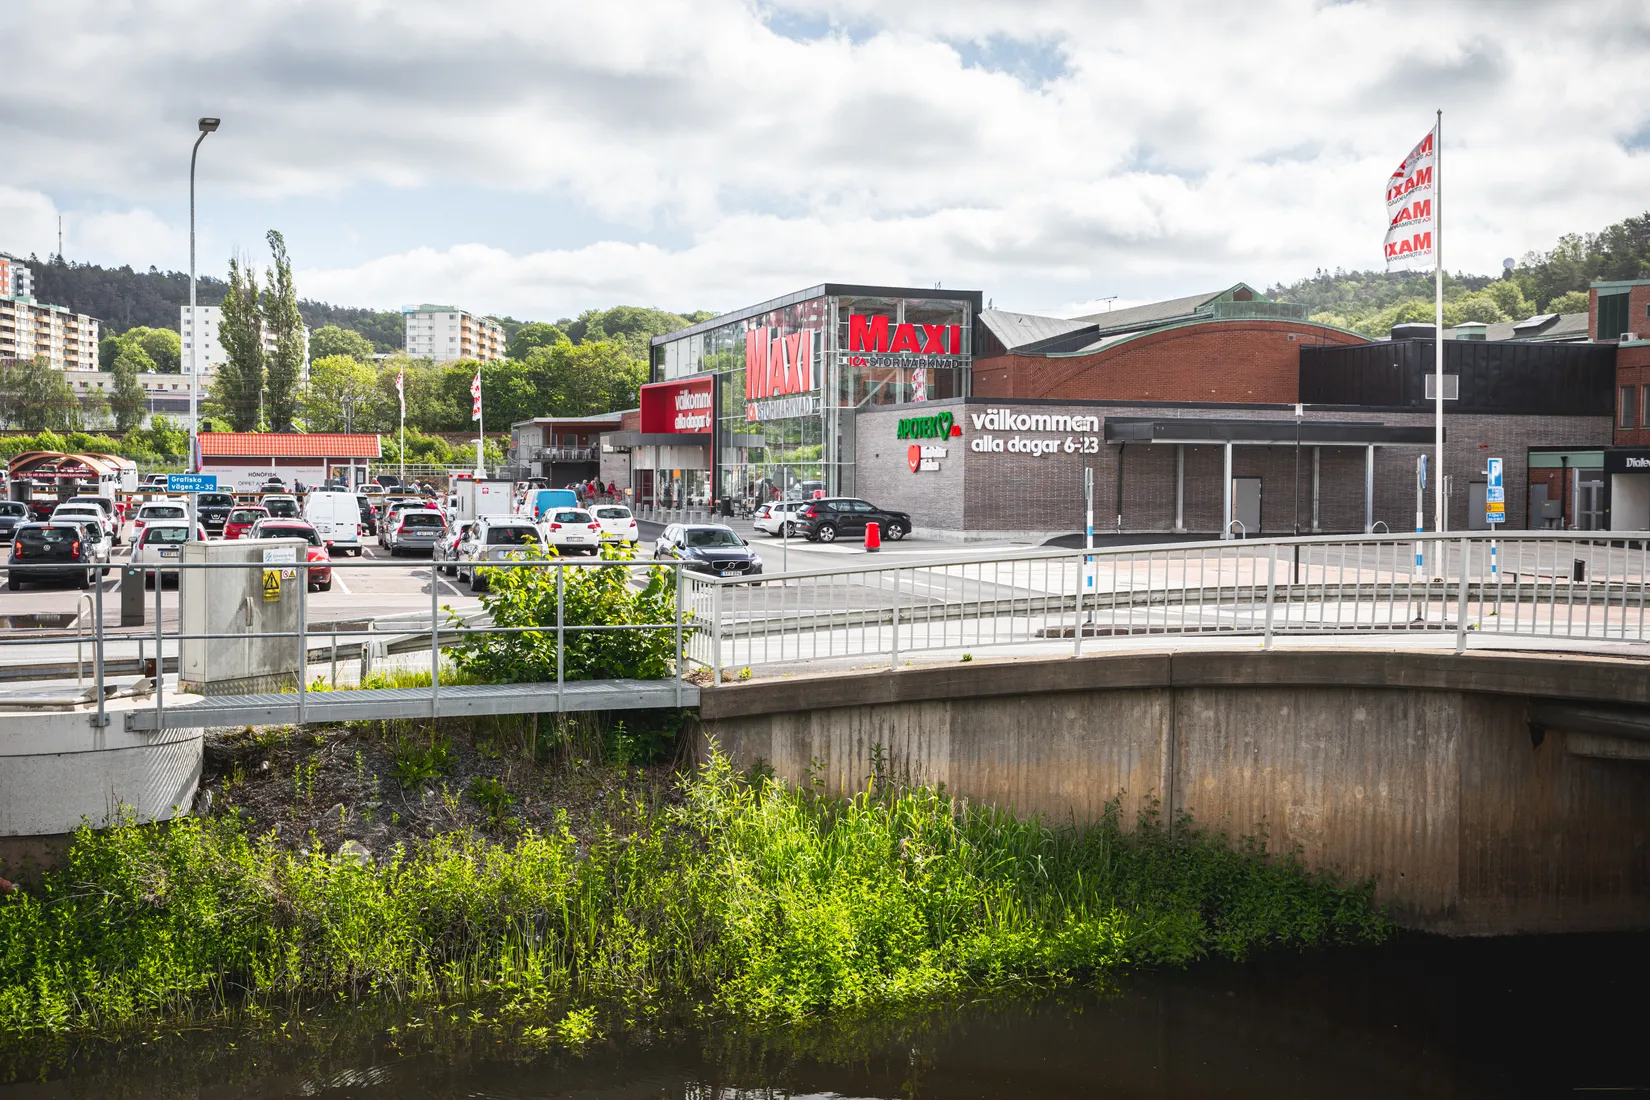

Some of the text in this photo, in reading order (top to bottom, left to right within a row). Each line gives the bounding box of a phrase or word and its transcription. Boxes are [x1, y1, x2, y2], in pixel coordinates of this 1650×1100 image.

[849, 314, 960, 354] MAXI
[746, 326, 814, 400] MAXI
[849, 356, 960, 369] ICA STORMARKNAD
[757, 396, 813, 421] STORMARKNAD
[971, 408, 1099, 432] välkommen
[686, 412, 705, 432] dagar
[897, 416, 938, 439] APOTEK
[971, 435, 1099, 457] alla dagar 6-23
